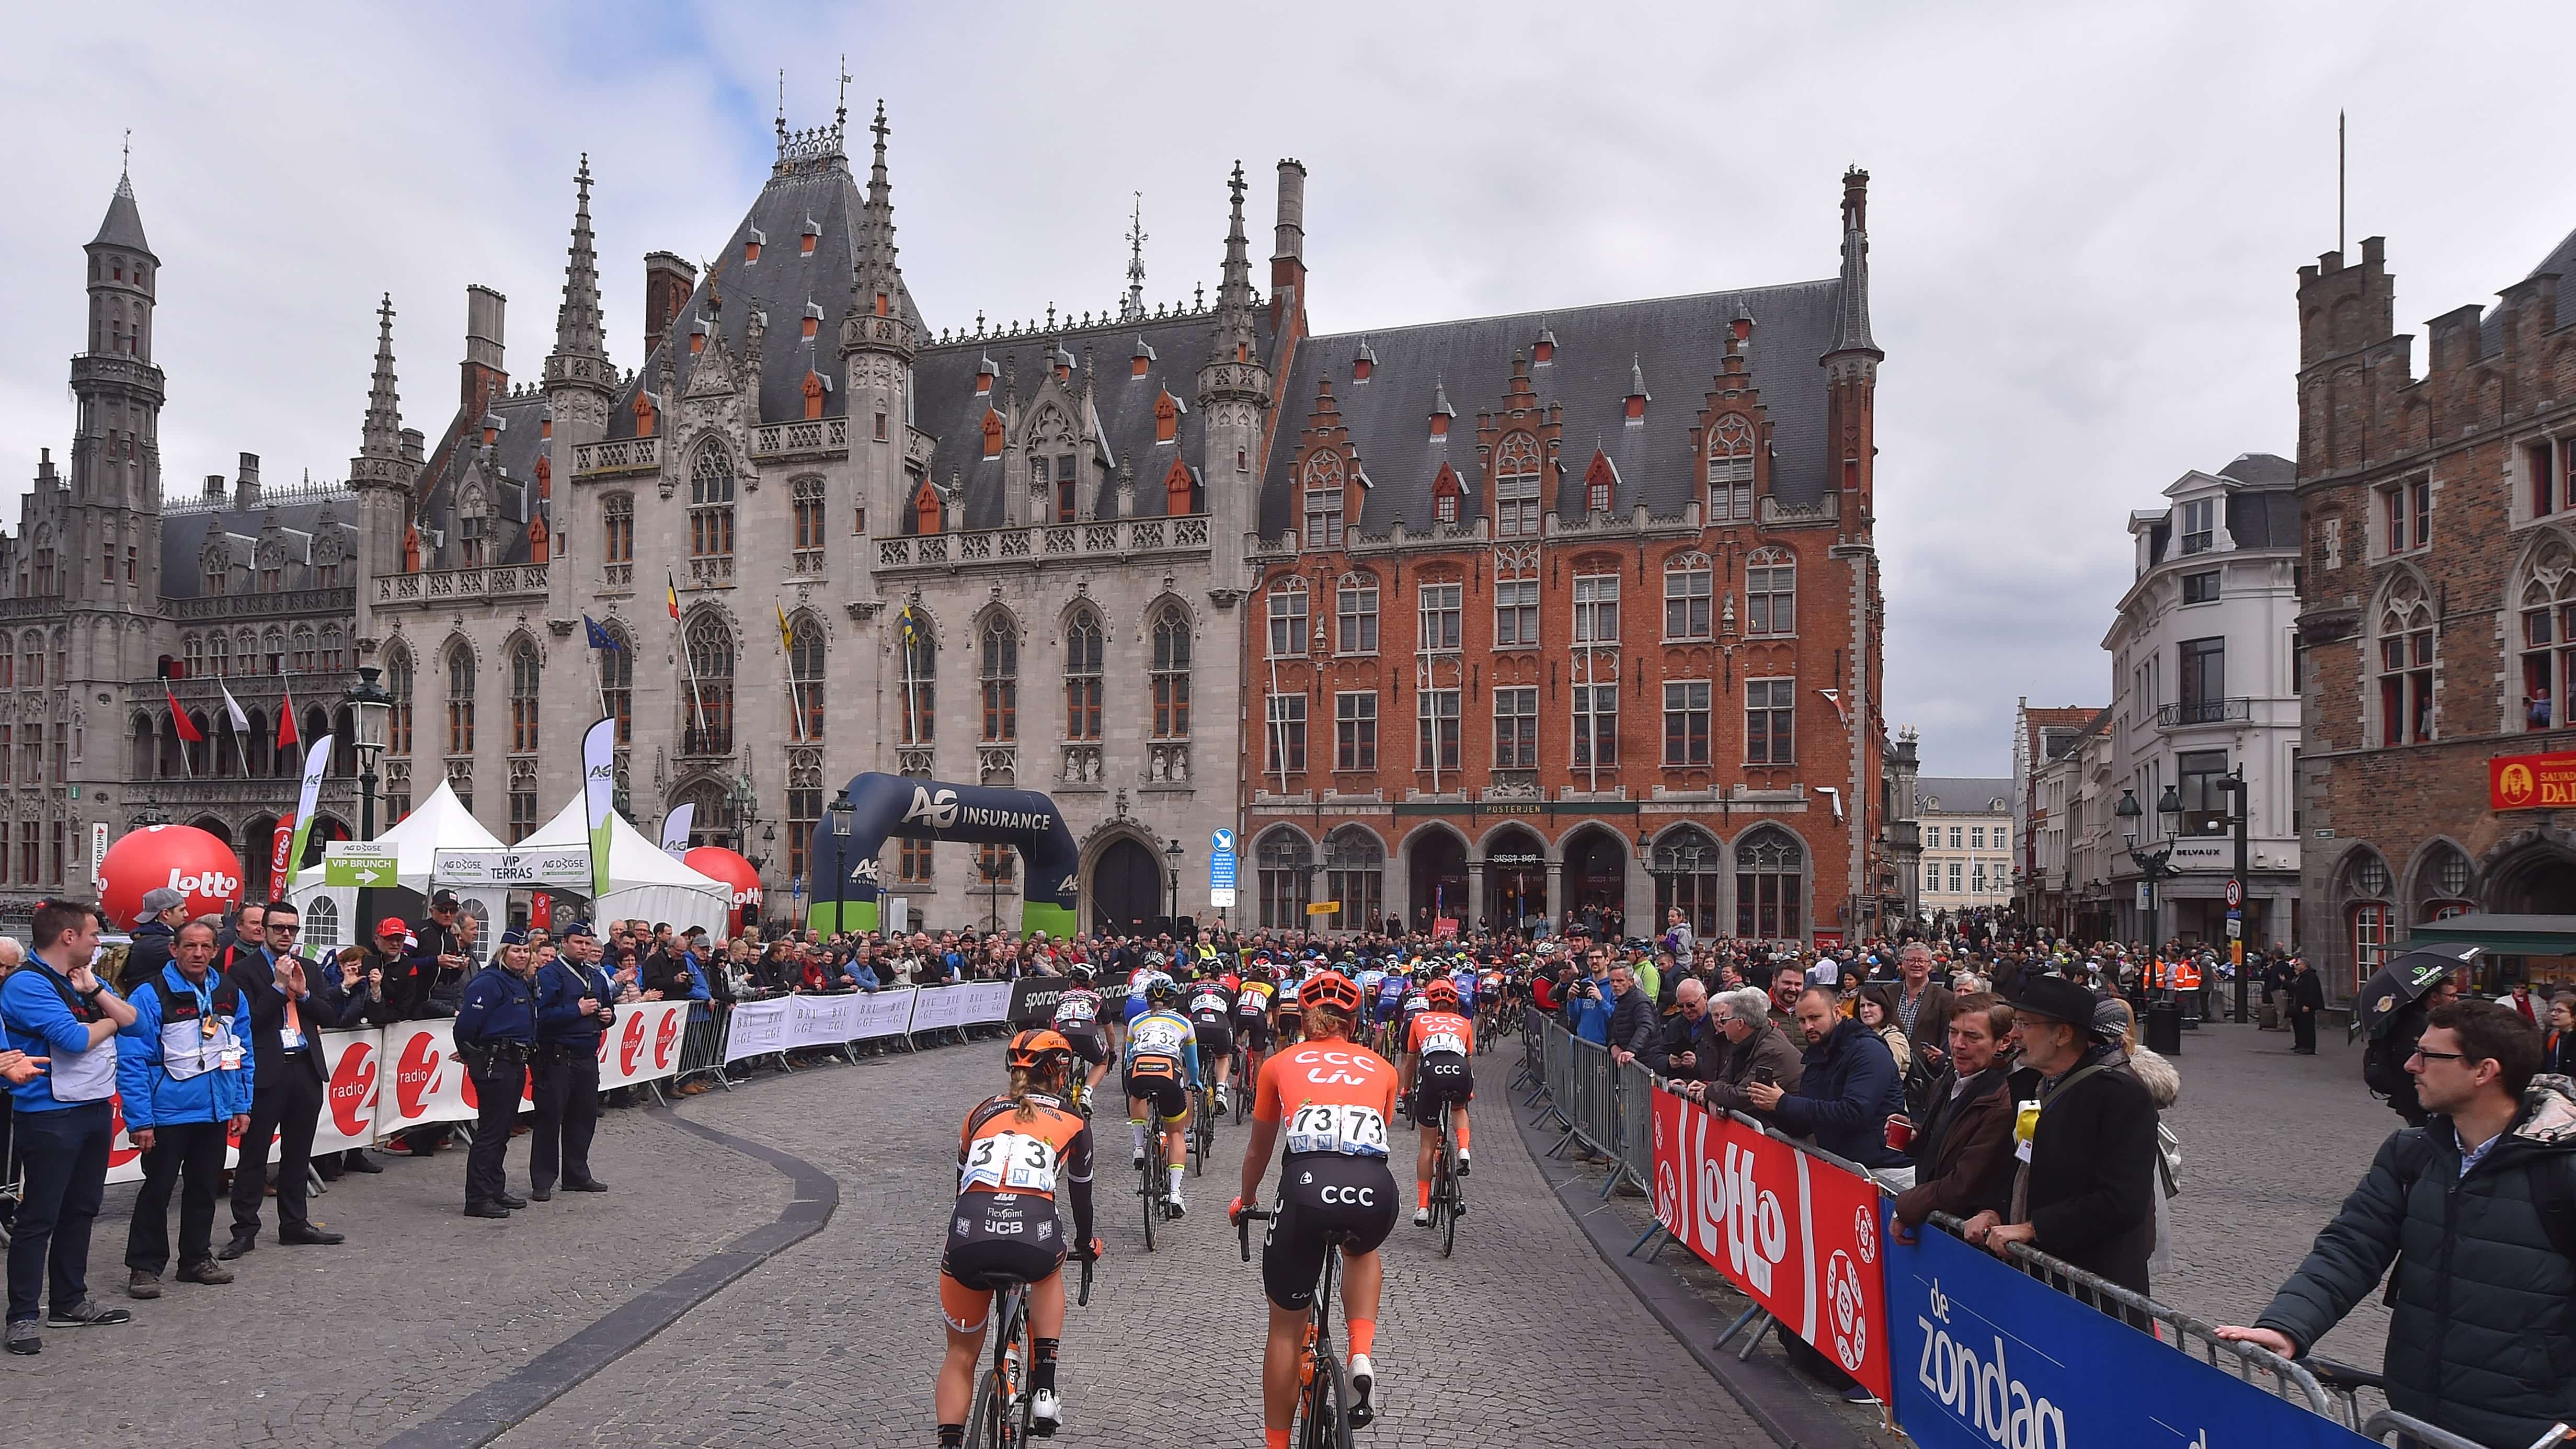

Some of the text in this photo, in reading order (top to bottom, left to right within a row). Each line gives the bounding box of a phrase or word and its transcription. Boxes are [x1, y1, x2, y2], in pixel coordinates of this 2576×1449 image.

[901, 786, 1050, 831] AG INSURANCE
[350, 860, 391, 868] BRUNCH
[502, 856, 520, 867] VIP
[491, 868, 533, 879] TERRAS
[890, 1001, 908, 1011] BRU
[1194, 995, 1206, 1005] 56
[797, 1008, 818, 1019] BRU
[832, 1006, 849, 1017] BRU
[860, 1004, 878, 1014] BRU
[1079, 1004, 1092, 1014] 55
[1419, 1016, 1463, 1026] CCC
[623, 1039, 638, 1050] radio
[657, 1033, 672, 1045] radio
[1160, 1032, 1176, 1047] 32
[1425, 1034, 1440, 1047] 71
[1295, 1051, 1376, 1073] CCC
[400, 1069, 427, 1083] radio
[1435, 1065, 1460, 1075] CCC
[1308, 1068, 1366, 1085] Liv
[333, 1081, 364, 1099] radio
[1298, 1109, 1382, 1144] 73 73
[972, 1141, 1046, 1169] 3 3
[1321, 1185, 1374, 1207] CCC
[987, 1207, 1023, 1220] Flexpoint
[985, 1219, 1024, 1235] JCB
[1930, 1277, 1950, 1324] de
